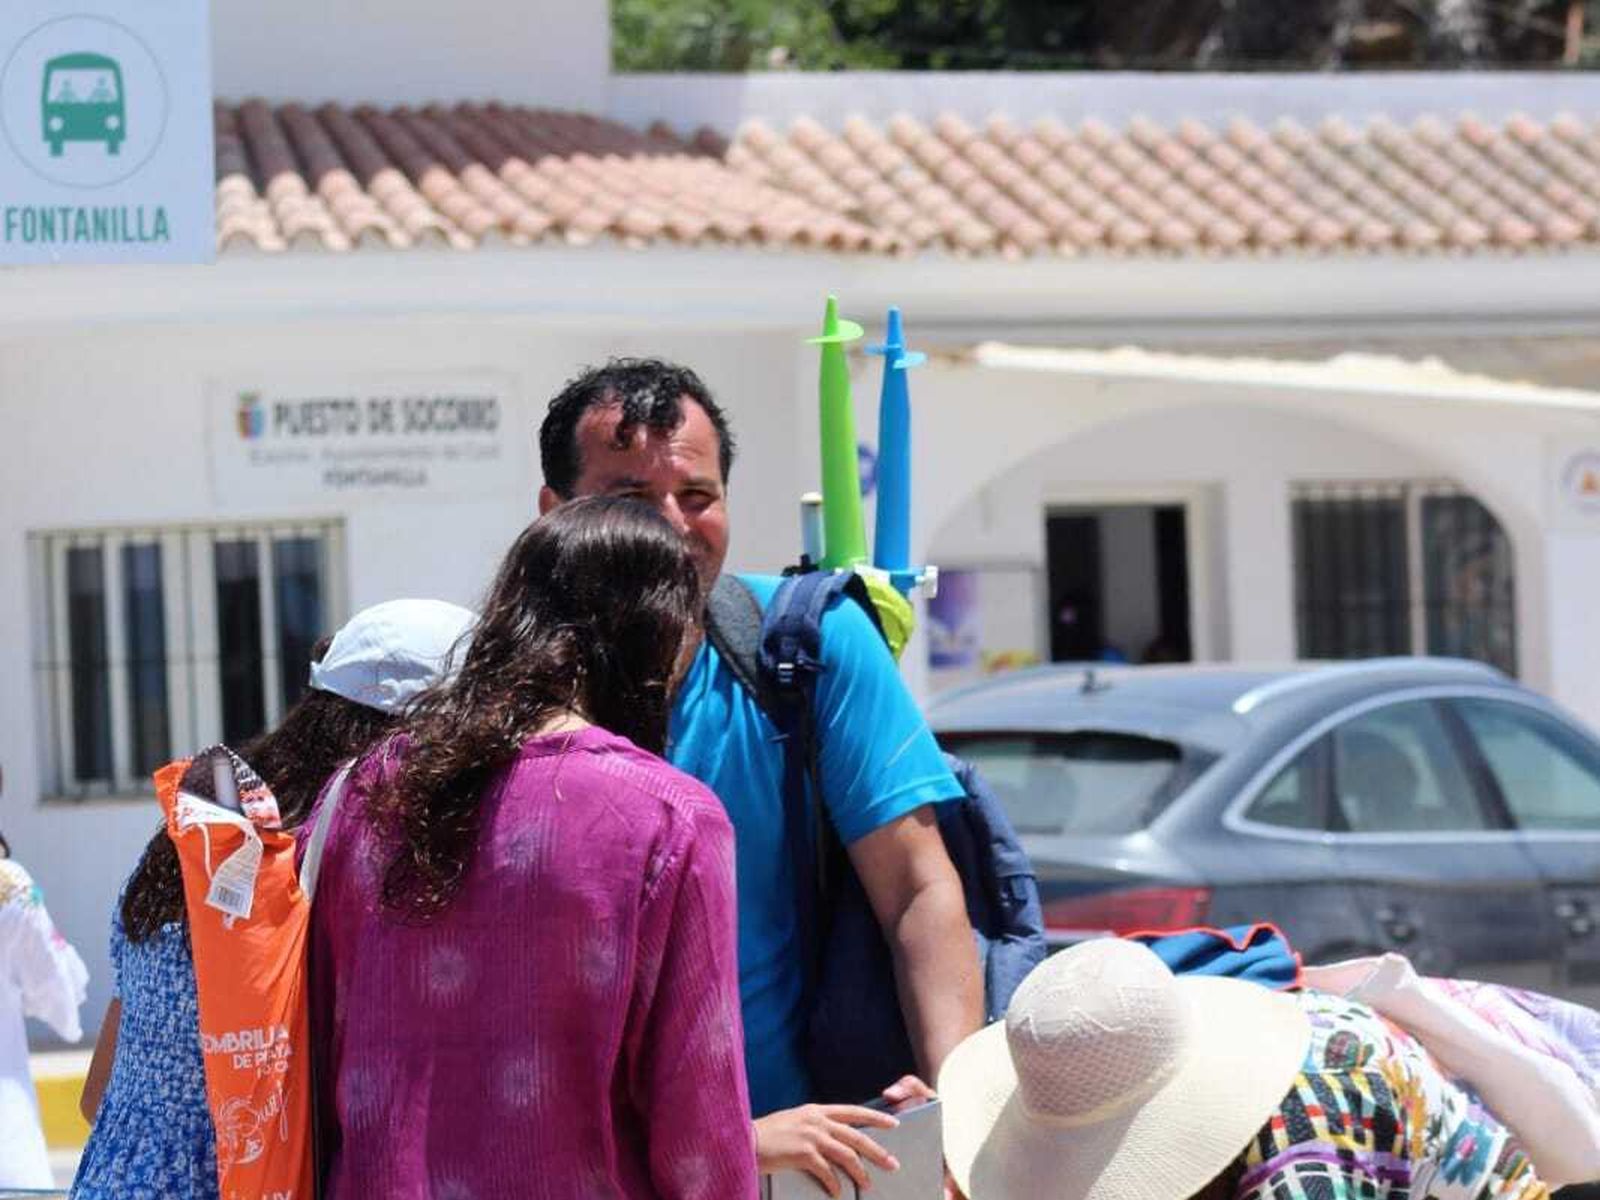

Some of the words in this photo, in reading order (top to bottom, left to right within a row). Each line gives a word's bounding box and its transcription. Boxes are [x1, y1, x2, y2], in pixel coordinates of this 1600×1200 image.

[5, 206, 170, 242] FONTANILLA
[272, 399, 358, 436] PUESTO
[368, 399, 394, 434] DE
[402, 397, 499, 434] SOCORRO
[199, 1025, 289, 1055] OMBRILLA
[233, 1053, 253, 1070] DE
